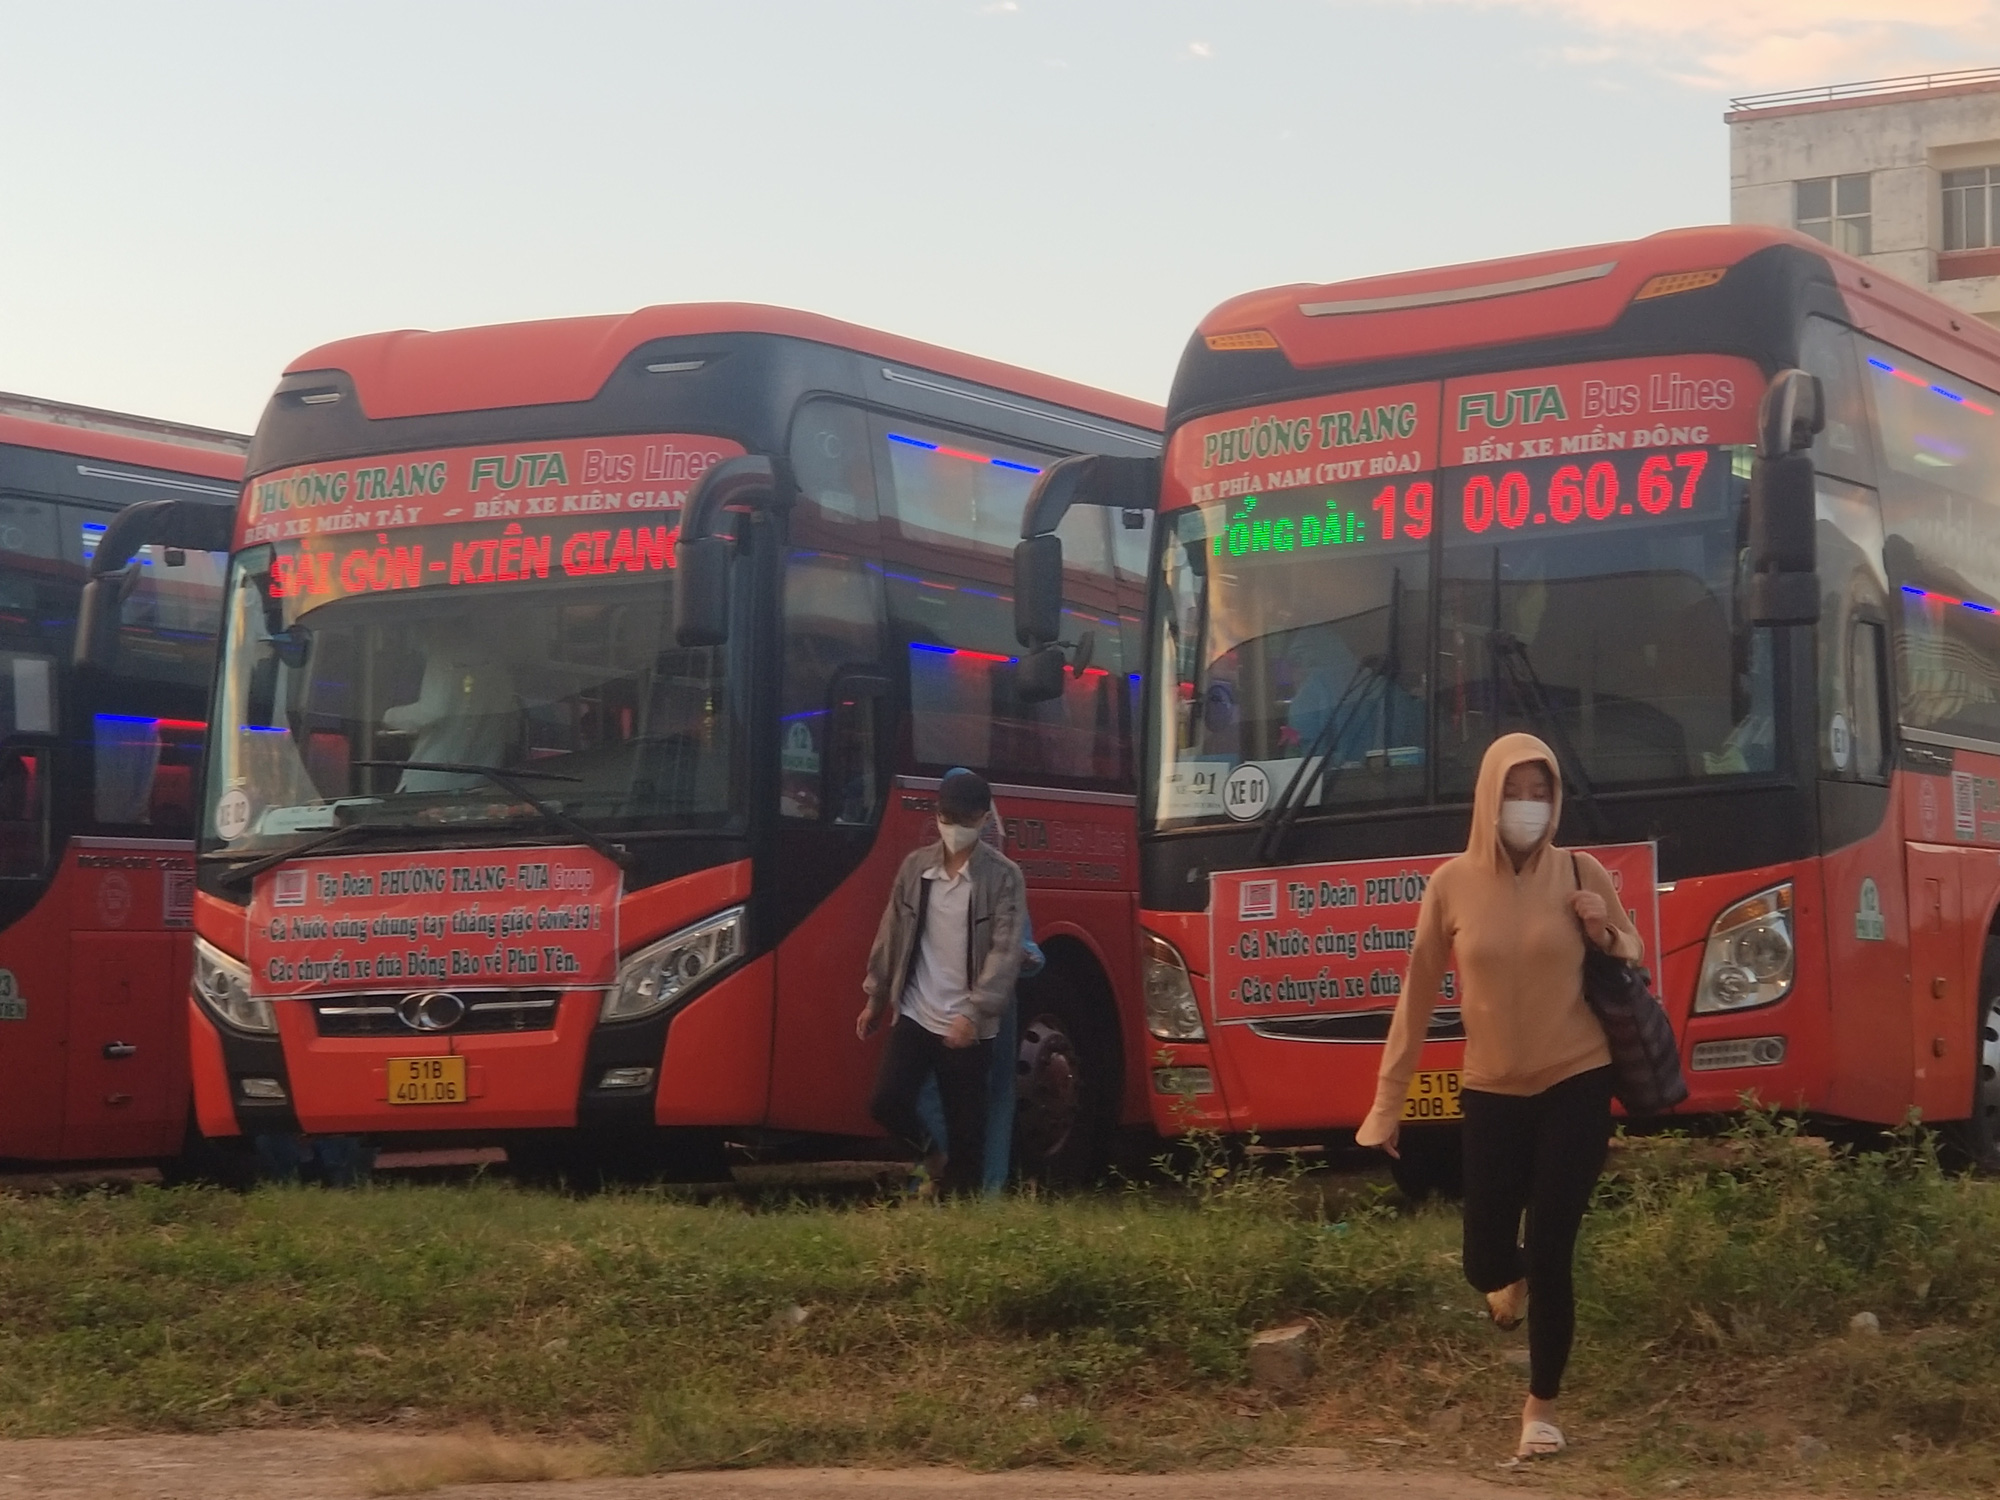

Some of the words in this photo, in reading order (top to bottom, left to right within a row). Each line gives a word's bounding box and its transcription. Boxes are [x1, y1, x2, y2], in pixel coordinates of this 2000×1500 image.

[1203, 415, 1312, 469] PHƯƠNG
[1319, 402, 1417, 448] TRANG
[1457, 384, 1569, 431] FUTA
[1581, 379, 1640, 419] Bus
[1650, 372, 1735, 412] Lines
[1462, 435, 1513, 465] BẾN
[1520, 438, 1554, 459] XE
[1560, 424, 1626, 455] MIỀN
[1632, 423, 1710, 448] ĐÔNG
[355, 461, 447, 502] TRANG
[468, 451, 569, 492] FUTA
[582, 449, 636, 485] Bus
[1218, 471, 1264, 498] PHÍA
[1267, 467, 1311, 491] NAM
[1315, 460, 1365, 485] (TUY
[1368, 451, 1421, 474] HÒA)
[244, 517, 281, 545] BẾN
[283, 518, 312, 537] XE
[315, 505, 371, 533] MIỀN
[376, 504, 423, 527] TÂY
[473, 493, 520, 519] BẾN
[525, 498, 557, 515] XE
[561, 490, 623, 512] KIÊN
[628, 491, 689, 508] GIAN
[1300, 499, 1366, 548] ĐÀI:
[1372, 481, 1434, 541] 19
[1462, 450, 1709, 534] 00.60.67
[269, 538, 335, 598] SÀI
[340, 533, 424, 593] GÒN
[450, 522, 552, 584] KIÊN
[1230, 780, 1246, 805] XE
[1250, 779, 1265, 804] 01
[341, 870, 373, 898] Đoàn
[379, 863, 446, 896] PHƯƠNG
[451, 865, 507, 893] TRANG
[516, 863, 550, 891] FUTA
[553, 862, 594, 896] Group
[1318, 878, 1358, 909] Đoàn
[1364, 869, 1432, 907] PHƯƠN
[290, 914, 329, 941] Nước
[332, 913, 369, 944] cùng
[372, 912, 419, 942] chung
[423, 911, 447, 940] tay
[452, 902, 497, 939] thắng
[1264, 928, 1311, 959] Nước
[1315, 925, 1358, 960] cùng
[268, 956, 293, 983] Các
[297, 949, 350, 985] chuyến
[354, 959, 371, 979] xe
[406, 945, 447, 982] Đồng
[451, 948, 479, 976] Bào
[484, 942, 503, 975] về
[507, 946, 538, 974] Phú
[542, 946, 580, 973] Yên.
[1241, 976, 1272, 1005] Các
[1277, 965, 1341, 1007] chuyến
[1344, 977, 1366, 999] xe
[1369, 968, 1402, 996] đưa
[410, 1060, 442, 1080] 51B
[1420, 1073, 1459, 1094] 51B
[396, 1082, 456, 1101] 401.06
[1404, 1096, 1462, 1118] 308.3
